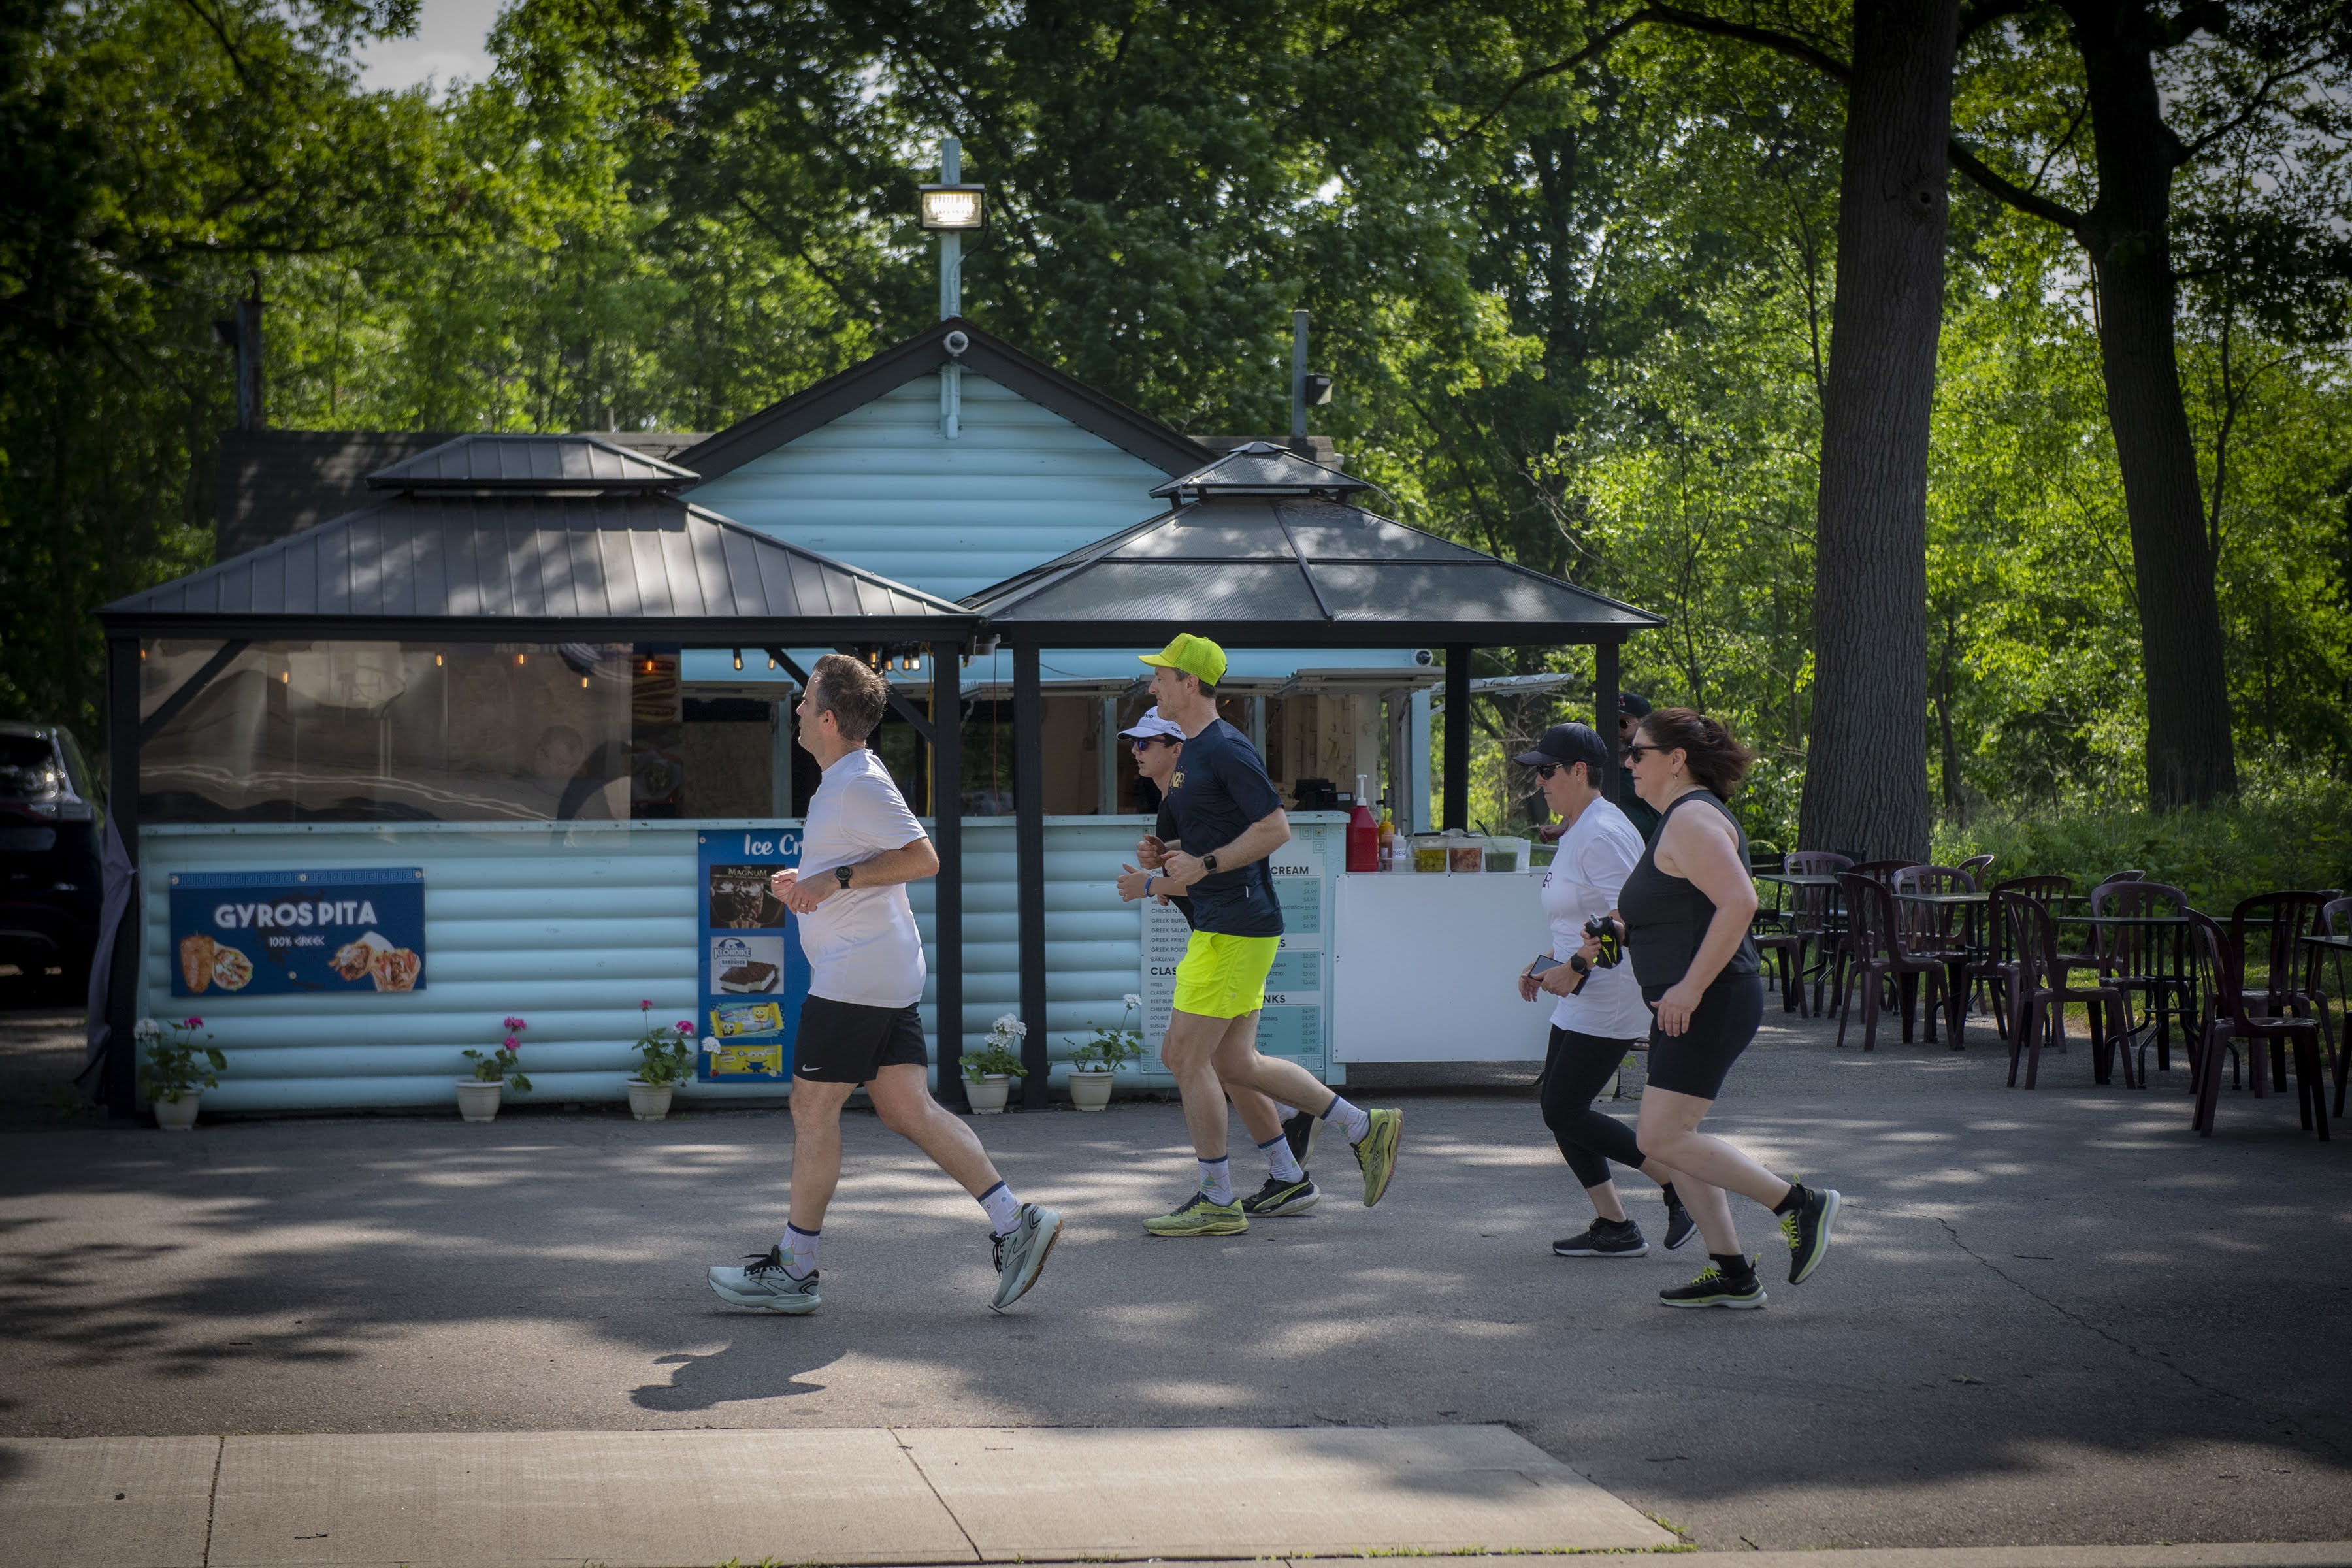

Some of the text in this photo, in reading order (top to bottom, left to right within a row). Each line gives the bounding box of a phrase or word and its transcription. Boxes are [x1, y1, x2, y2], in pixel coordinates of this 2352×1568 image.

[744, 834, 802, 855] Ice Cr
[1271, 866, 1309, 875] CREAM
[215, 900, 378, 928] GYROS PITA
[269, 936, 325, 947] 100% GREEK
[714, 948, 751, 959] KLONDIKE
[1151, 967, 1177, 975] CLAS
[1264, 994, 1286, 1004] NKS
